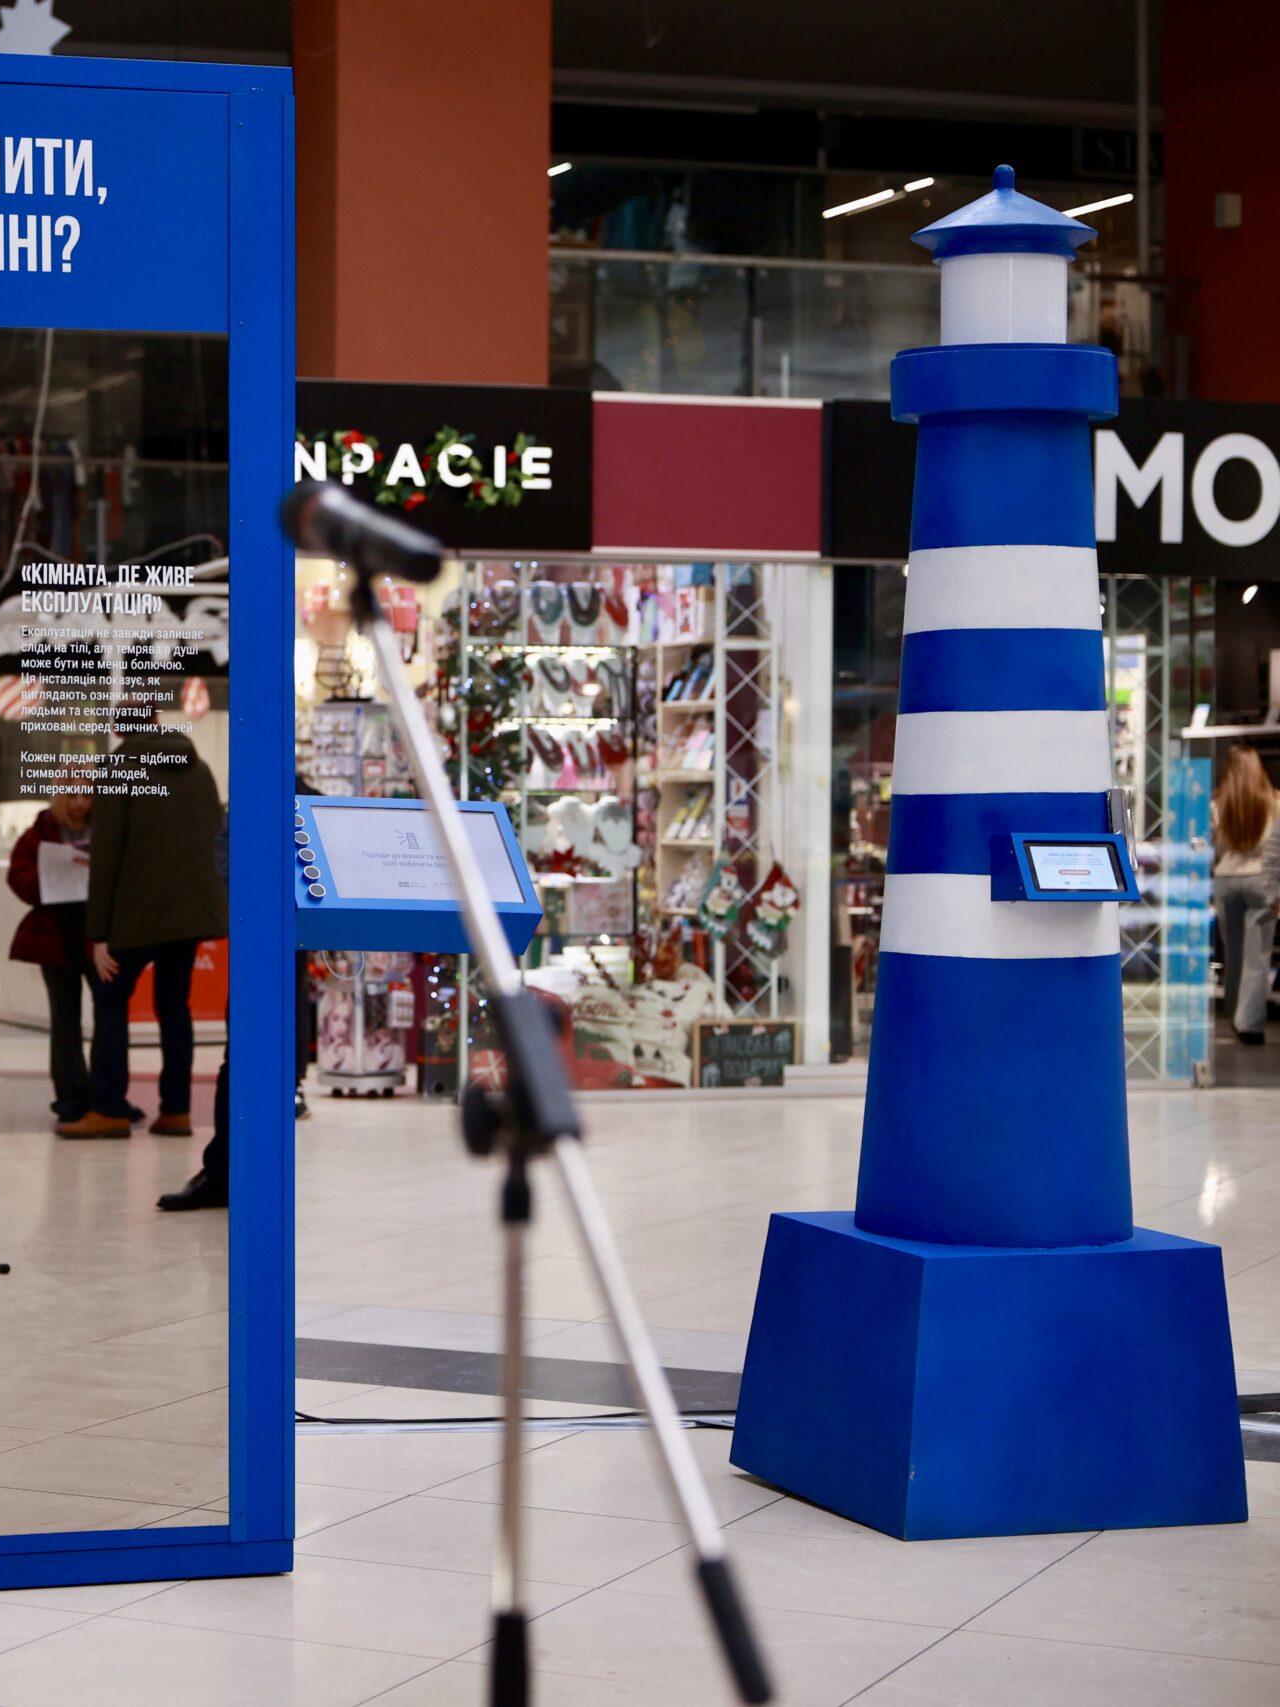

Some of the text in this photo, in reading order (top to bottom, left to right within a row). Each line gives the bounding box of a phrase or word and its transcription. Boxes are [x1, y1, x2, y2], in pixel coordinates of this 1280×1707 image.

[21, 563, 195, 588] «КІМНАТА, ДЕ ЖИВЕ
[21, 590, 162, 616] ЕКСПЛУАТАЦІЯ»
[21, 626, 93, 638] Експлуатація
[112, 630, 153, 639] завжди
[156, 631, 204, 639] залишає
[21, 642, 51, 654] сліди
[54, 645, 67, 653] на
[70, 643, 91, 655] тілі,
[94, 646, 113, 654] але
[117, 646, 161, 657] темрява
[173, 645, 199, 657] душі
[21, 657, 185, 671] може бути не менш болючою.
[21, 672, 160, 687] Ця інсталяція показує, як
[21, 691, 173, 703] виглядають ознаки торгівлі
[20, 706, 65, 716] людьми
[69, 707, 80, 716] та
[83, 705, 152, 719] експлуатації
[21, 722, 196, 735] приховані серед звичних речей.
[21, 751, 55, 762] Кожен
[59, 753, 106, 765] предмет
[109, 754, 125, 765] тут
[140, 752, 187, 765] відбиток
[26, 770, 67, 779] символ
[71, 768, 108, 781] історій
[111, 769, 150, 781] людей,
[20, 784, 171, 797] які пережили такий досвід.
